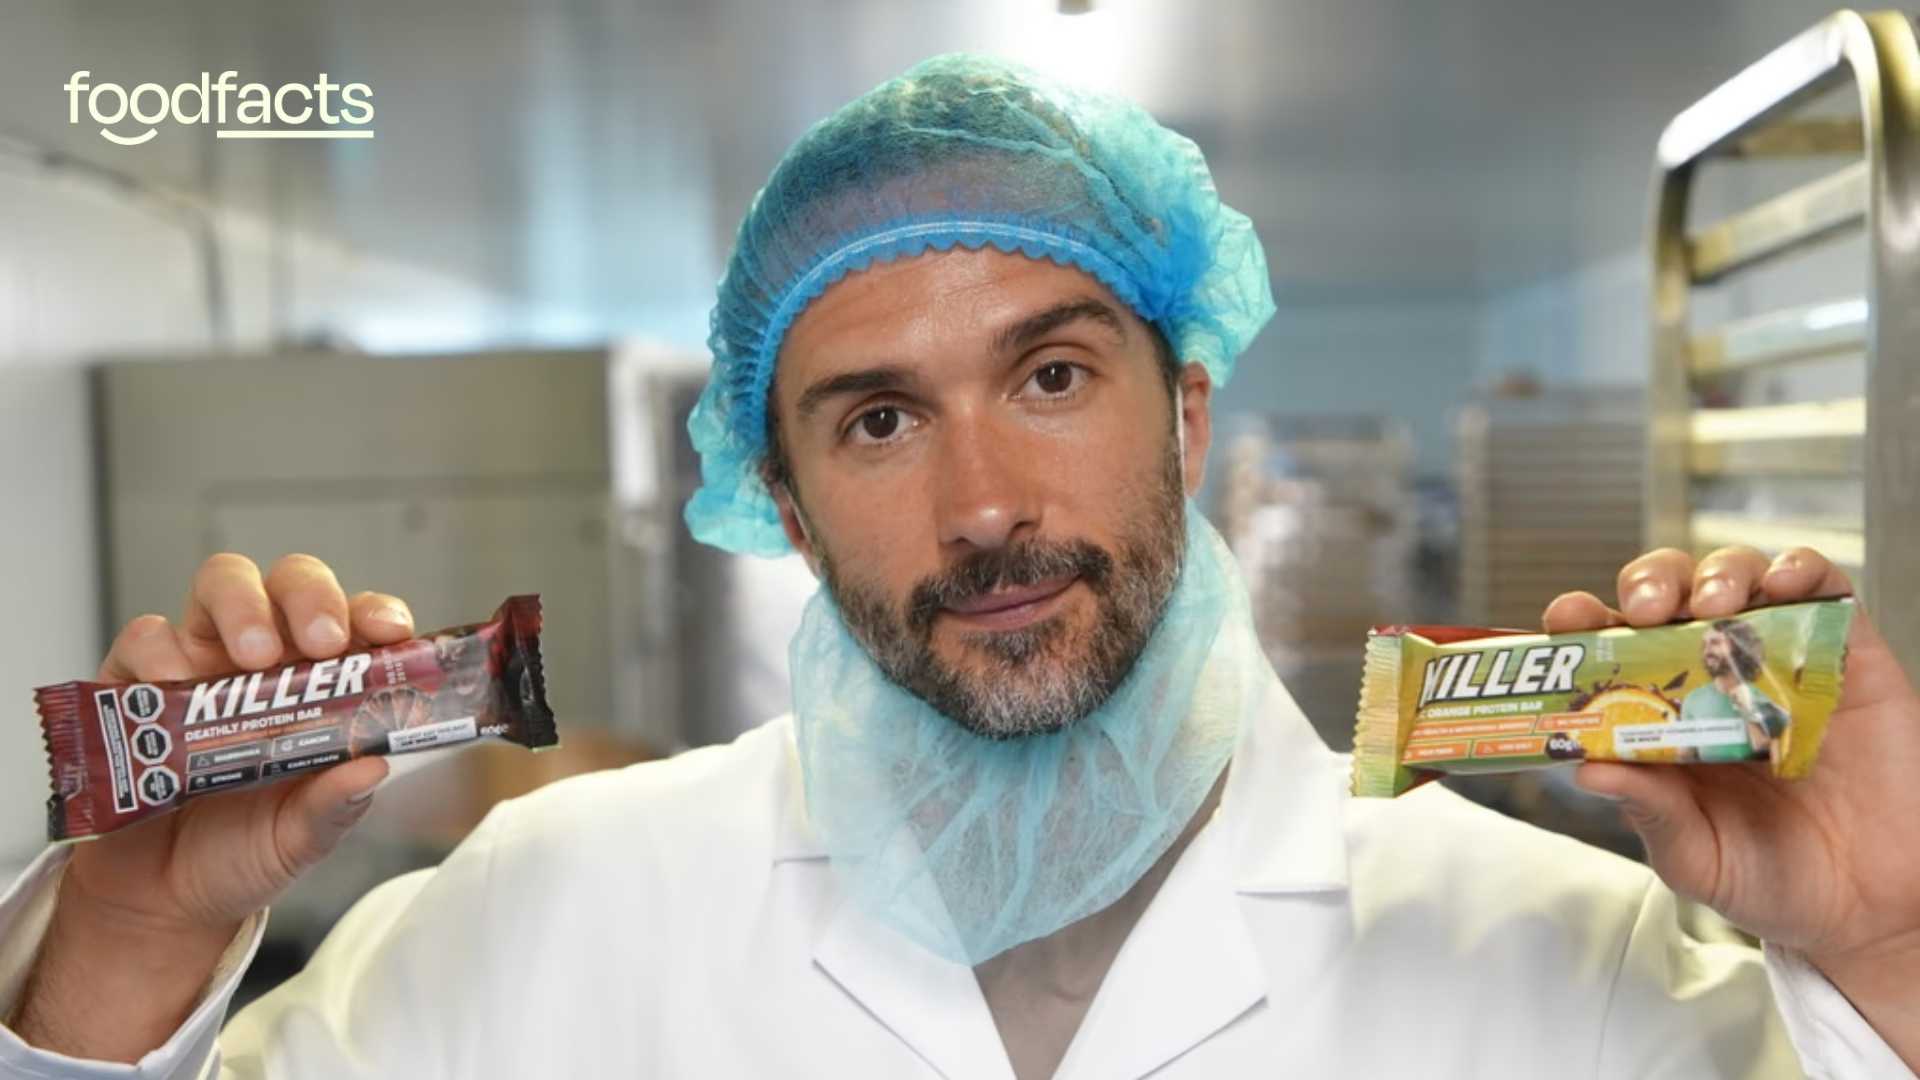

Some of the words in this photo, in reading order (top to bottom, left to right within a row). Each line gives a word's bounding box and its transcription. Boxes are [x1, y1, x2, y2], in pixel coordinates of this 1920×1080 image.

[182, 652, 373, 726] KILLER
[184, 722, 239, 742] DEATHLY
[242, 712, 296, 730] PROTEIN
[297, 707, 323, 721] BAR
[1473, 702, 1519, 716] PROTEIN
[1520, 700, 1544, 712] BAR
